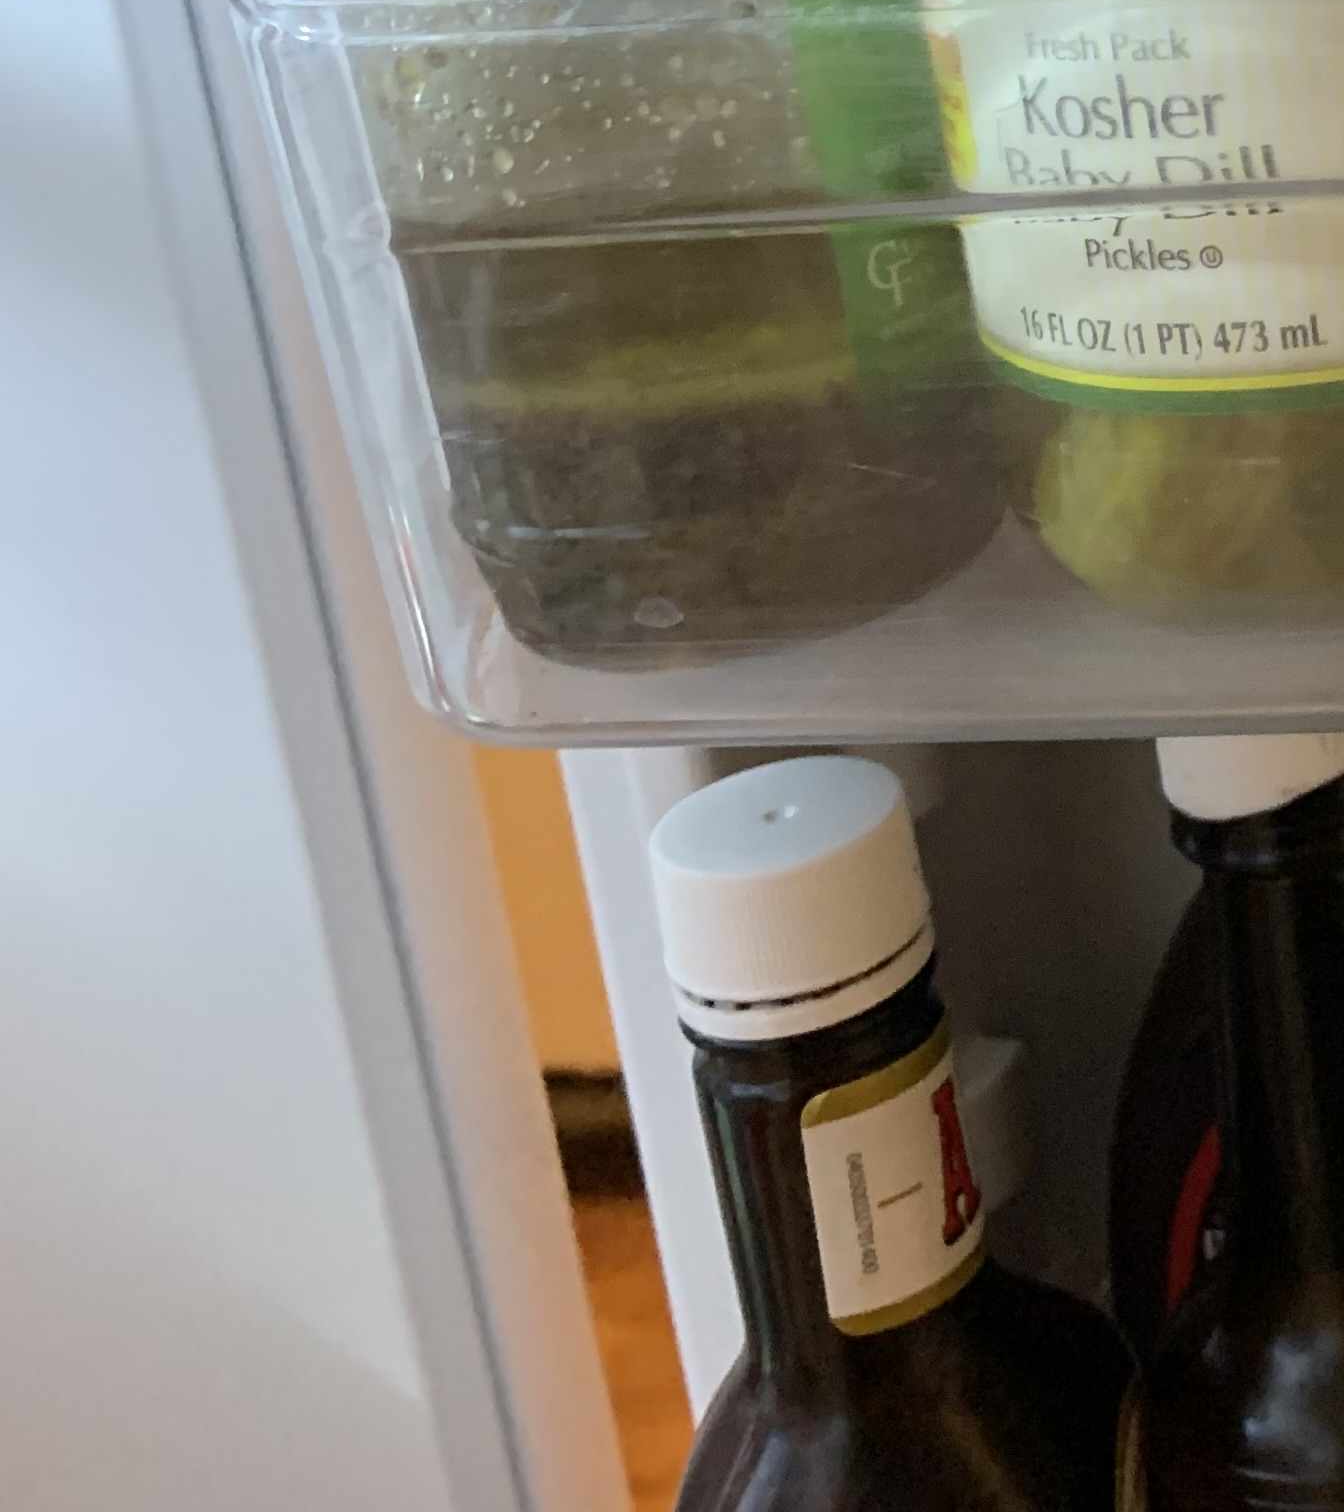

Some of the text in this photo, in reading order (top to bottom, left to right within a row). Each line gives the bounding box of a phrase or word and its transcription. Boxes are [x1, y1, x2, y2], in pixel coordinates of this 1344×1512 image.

[1024, 28, 1191, 62] Fresh Pack
[1018, 74, 1225, 140] Kosher
[1085, 239, 1191, 271] Pickles
[1021, 306, 1327, 360] 16 FL OZ (1 PT) 473 mL
